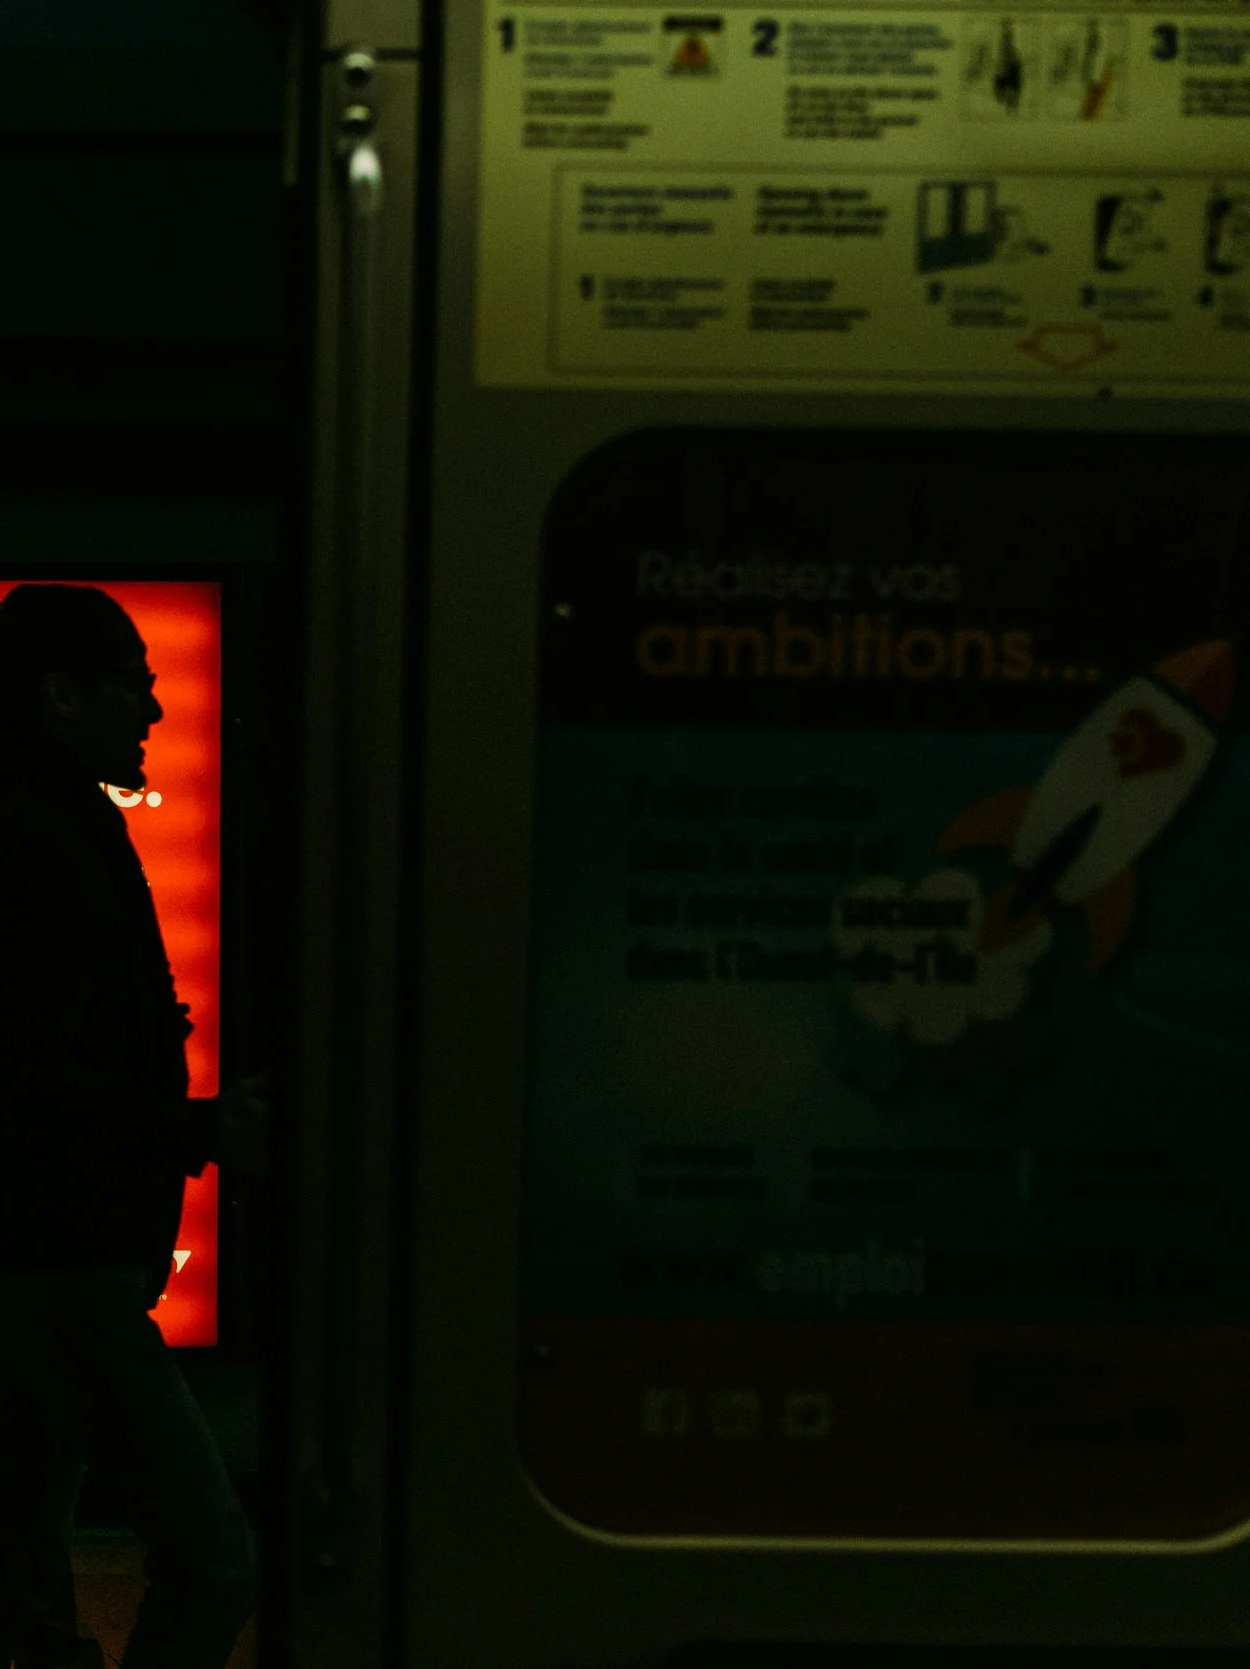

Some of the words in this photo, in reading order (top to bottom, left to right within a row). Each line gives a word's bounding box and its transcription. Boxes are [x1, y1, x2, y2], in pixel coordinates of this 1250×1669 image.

[499, 18, 515, 52] 1
[752, 19, 779, 57] 2
[636, 549, 852, 600] Réalisez
[866, 562, 962, 600] vos
